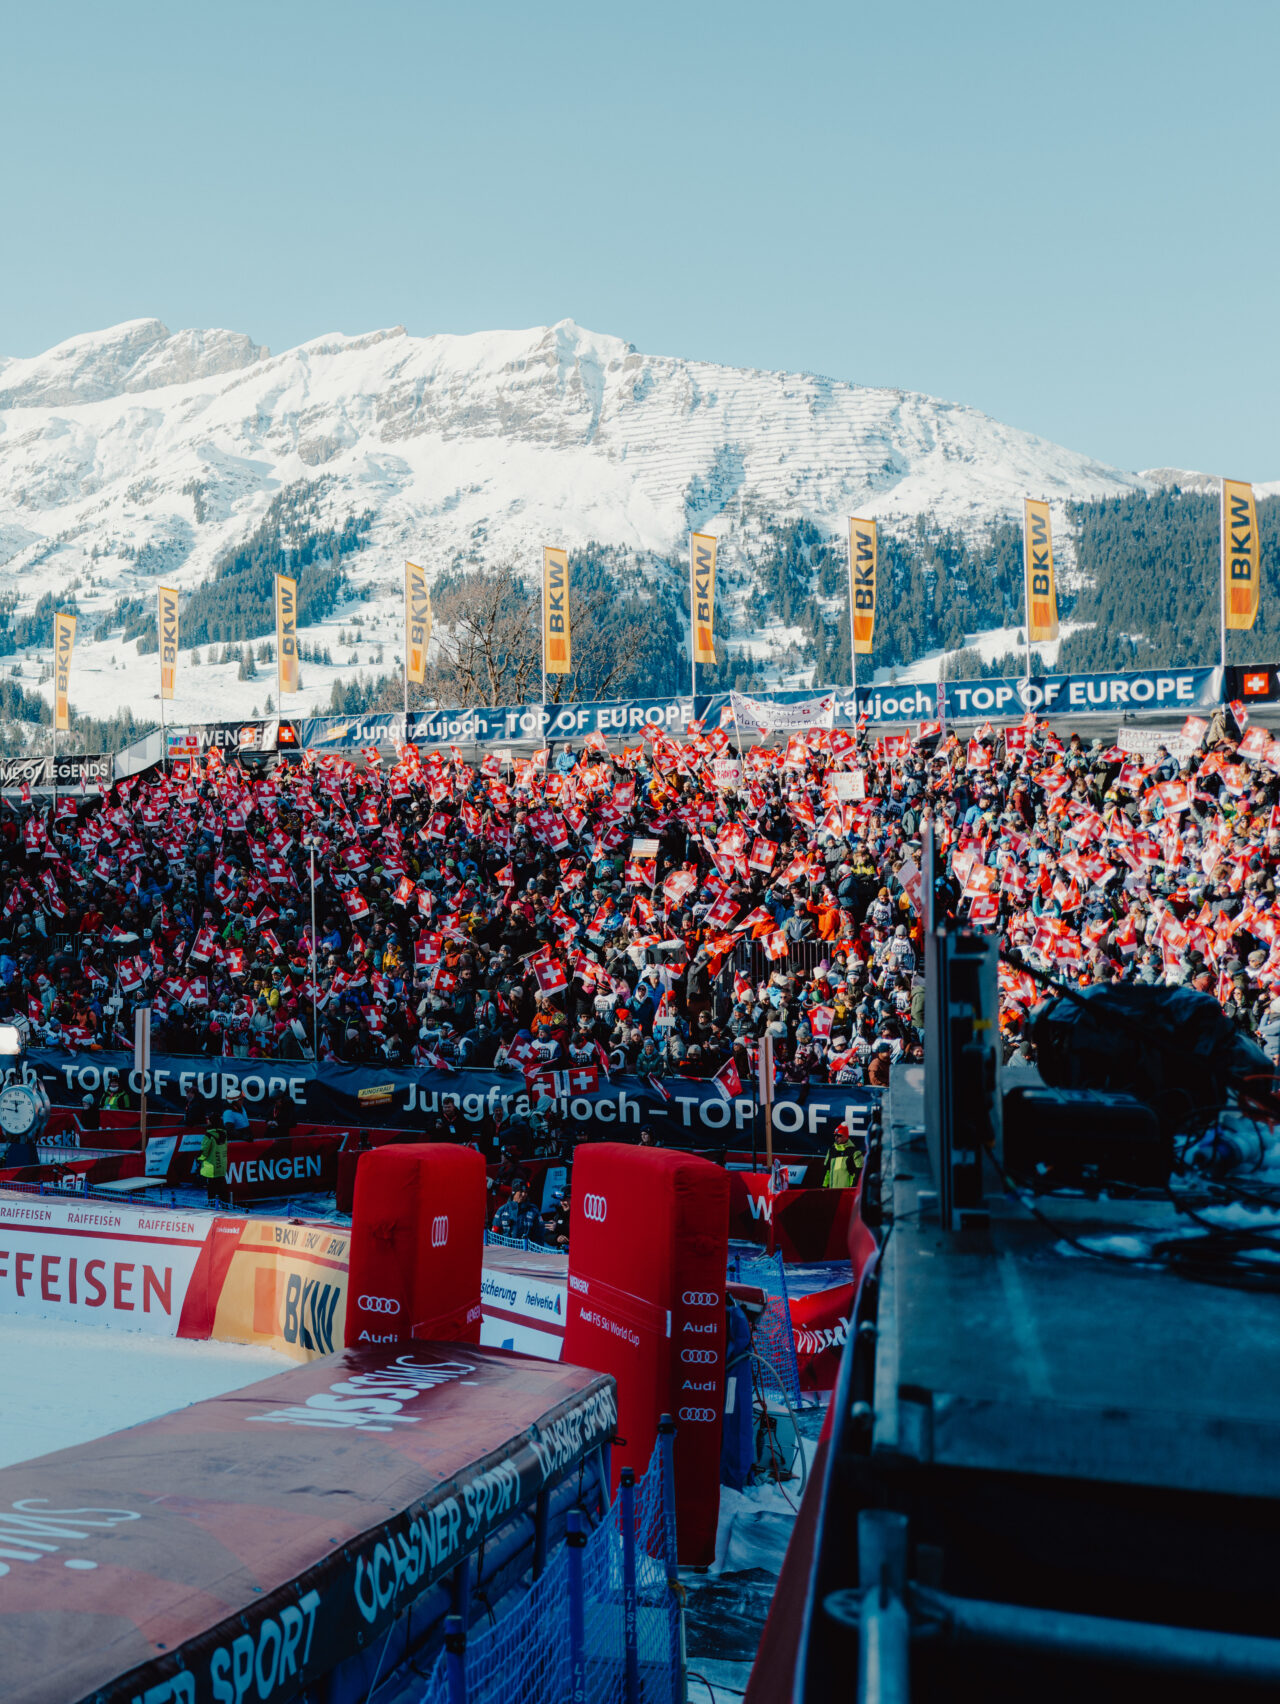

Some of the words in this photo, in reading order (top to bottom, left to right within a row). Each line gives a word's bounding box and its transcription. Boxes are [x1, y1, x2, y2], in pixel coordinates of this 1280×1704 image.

[1031, 513, 1049, 595] BKW
[1231, 495, 1251, 580] BKW
[695, 545, 712, 622] BKW
[855, 530, 875, 610] BKW
[411, 573, 428, 644] BKW
[550, 560, 565, 633] BKW
[164, 597, 176, 663] BKW
[57, 625, 72, 693] BKW
[834, 690, 932, 719] raujoch
[955, 687, 1013, 710] TOP
[1020, 683, 1061, 706] OF
[1069, 676, 1195, 704] EUROPE
[353, 714, 488, 741] Jungfraujoch
[505, 711, 550, 732] TOP
[557, 709, 590, 730] OF
[597, 705, 693, 728] EUROPE
[23, 765, 43, 779] OF
[45, 763, 109, 779] LEGENDS
[127, 1069, 171, 1095] OF
[675, 1096, 758, 1130] TOP
[771, 1101, 830, 1134] OF
[225, 1154, 322, 1185] WENGEN
[0, 1207, 52, 1221] RAIFFEISEN
[67, 1213, 121, 1227] RAIFFEISEN
[138, 1219, 195, 1233] RAIFFEISEN
[275, 1227, 300, 1246] BKW
[327, 1238, 347, 1257] BKW
[283, 1273, 341, 1354] BKW
[525, 1291, 553, 1310] helvetia
[358, 1329, 399, 1344] Audi
[579, 1307, 593, 1322] Audi
[592, 1312, 601, 1327] FIS
[601, 1317, 610, 1332] Ski
[610, 1321, 628, 1340] World
[628, 1329, 640, 1347] Cup
[682, 1321, 718, 1334] Audi
[681, 1380, 717, 1392] Audi
[530, 1410, 584, 1480] OCHSNER
[583, 1385, 618, 1441] SPORT
[353, 1497, 462, 1624] OCHSNER
[463, 1459, 522, 1540] SPORT
[210, 1588, 321, 1704] SPORT
